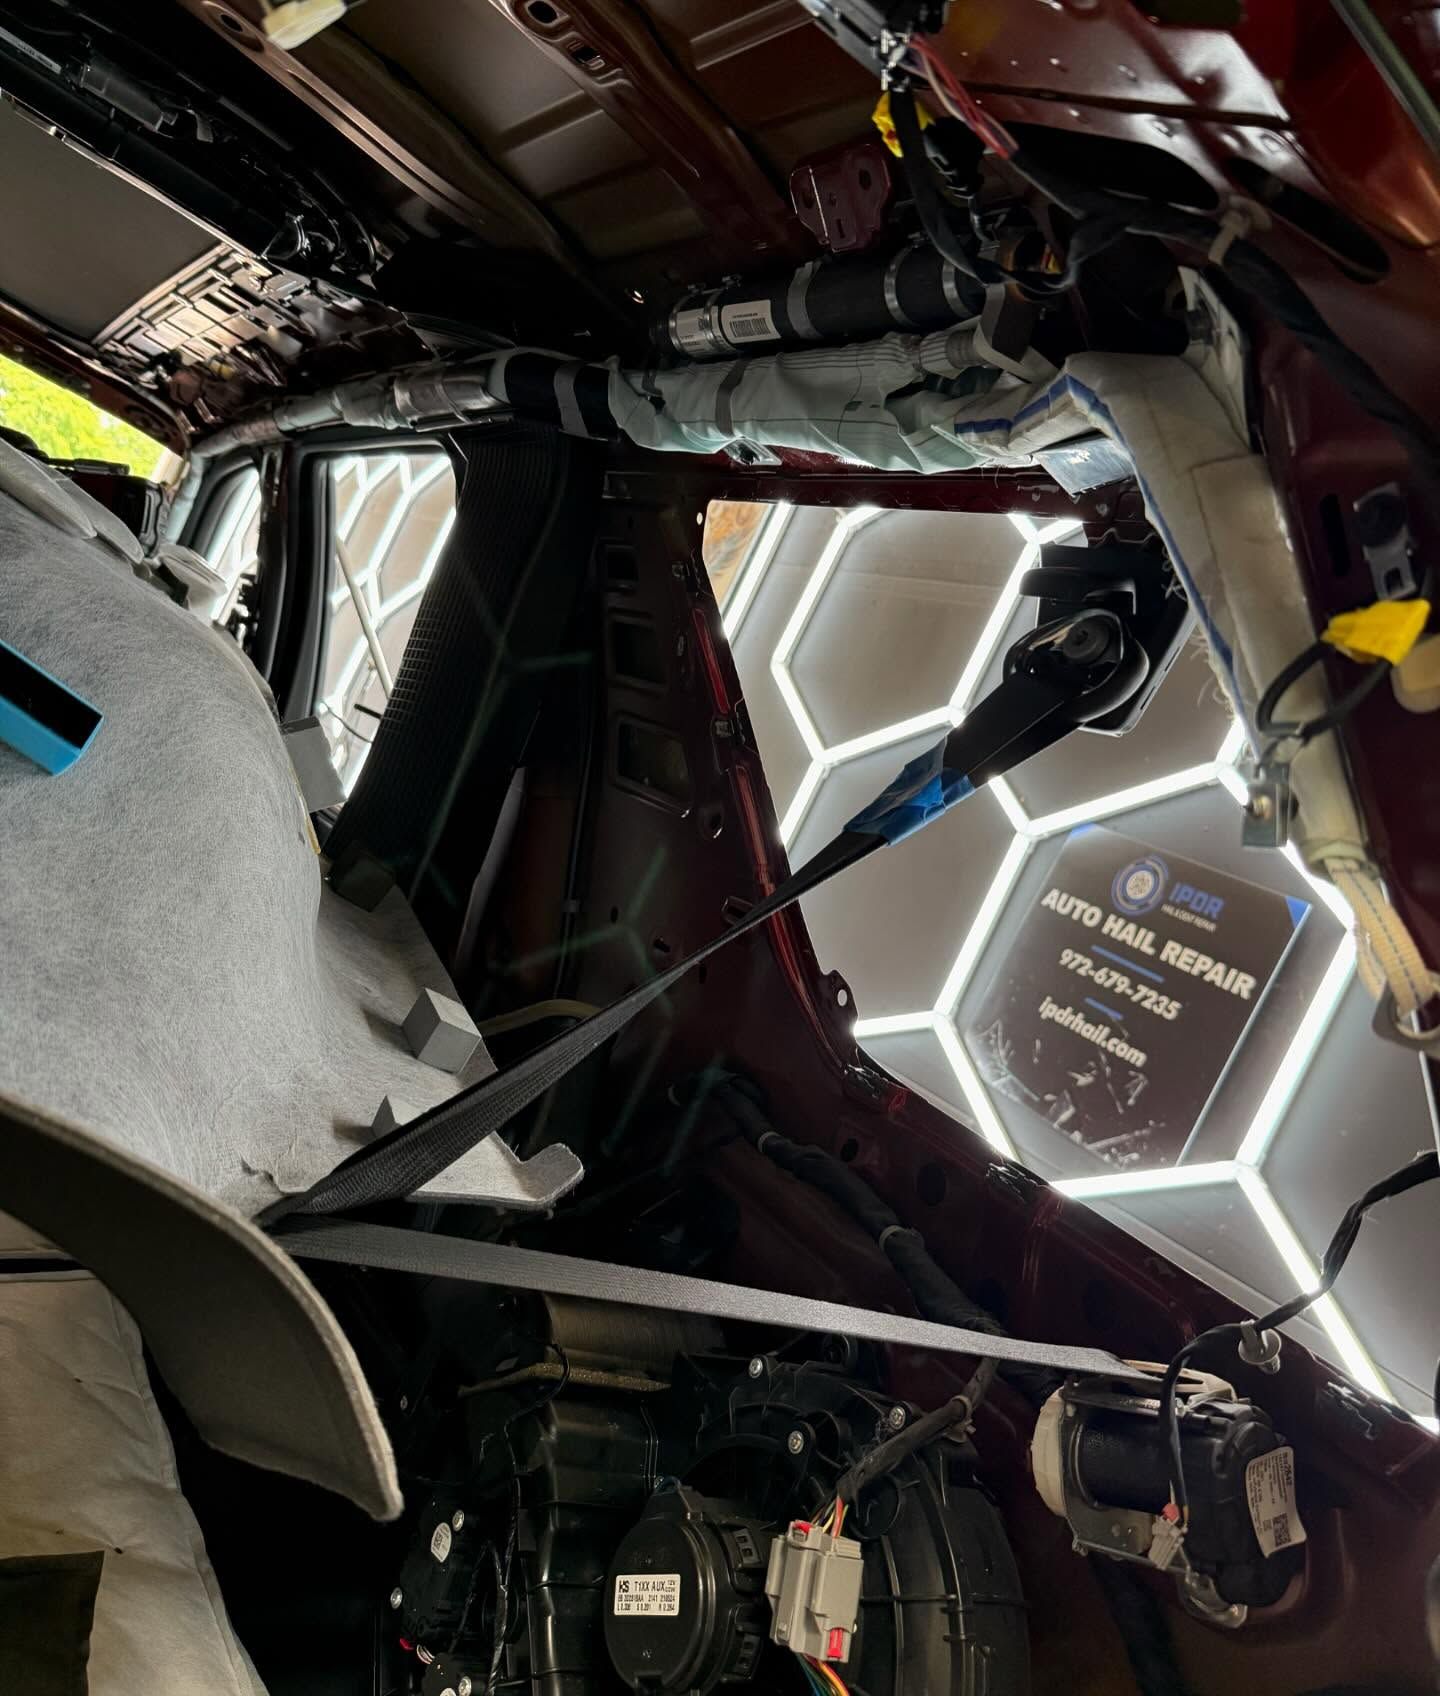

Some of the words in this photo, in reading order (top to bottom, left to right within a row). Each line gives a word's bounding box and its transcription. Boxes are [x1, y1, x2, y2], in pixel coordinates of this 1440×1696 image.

[1041, 888, 1102, 928] AUTO
[1102, 913, 1156, 955] HAIL
[1160, 939, 1257, 1000] REPAIR
[1059, 948, 1184, 1021] 972-679-7235
[1038, 996, 1149, 1068] ipdrhail.com
[651, 1581, 666, 1592] AUX
